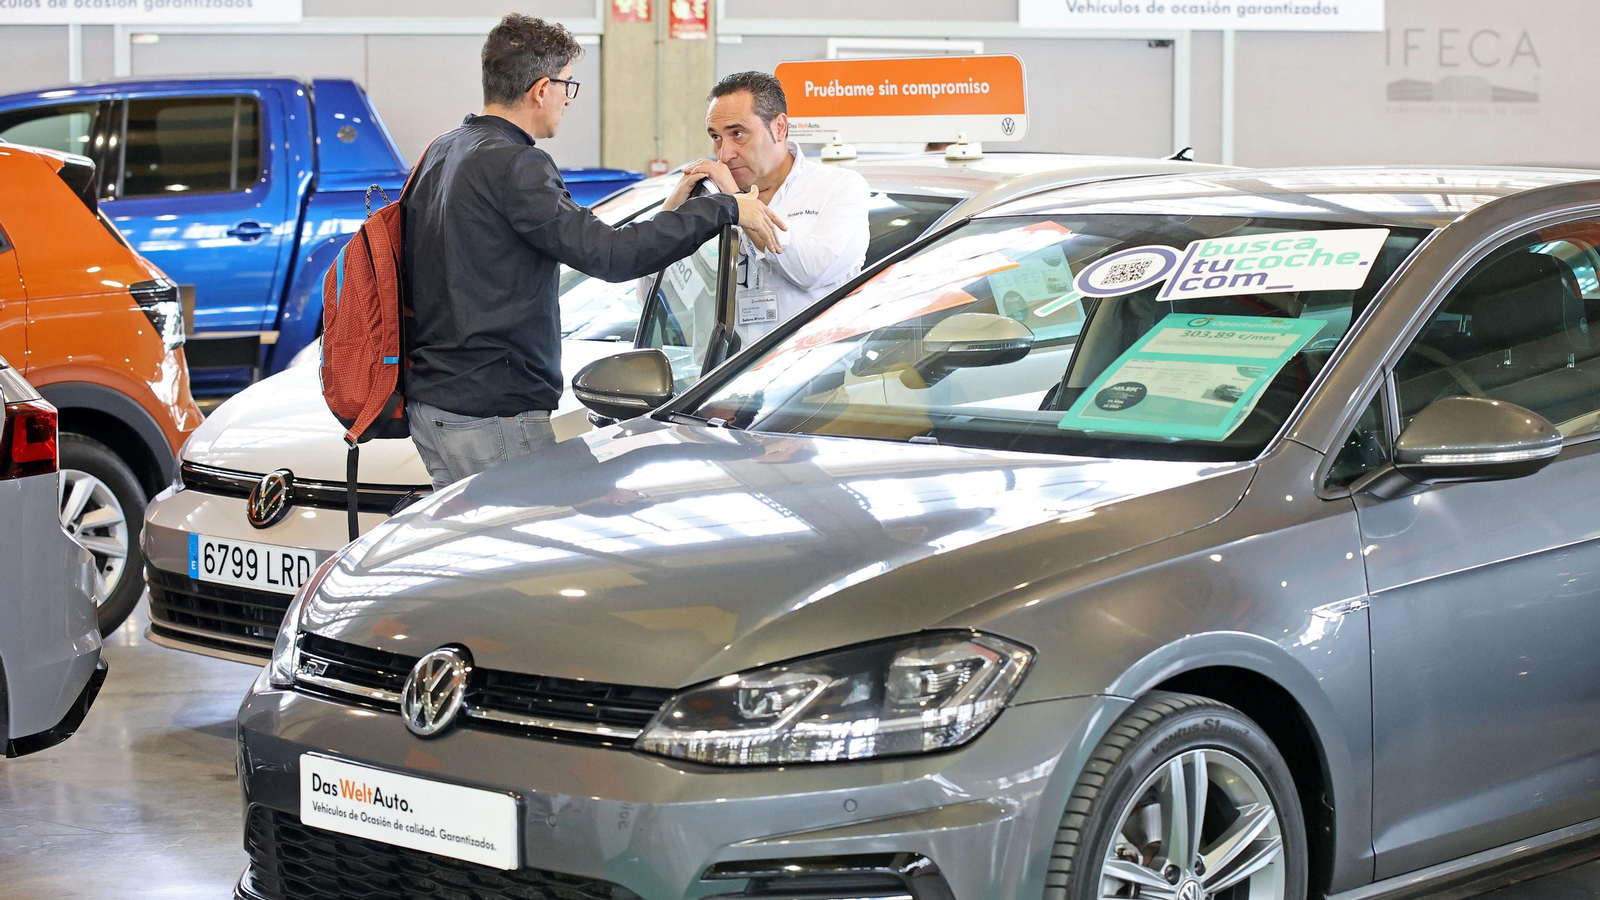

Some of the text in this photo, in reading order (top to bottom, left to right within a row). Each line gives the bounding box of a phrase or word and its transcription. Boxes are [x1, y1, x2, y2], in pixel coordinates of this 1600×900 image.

[1146, 0, 1165, 14] de
[1171, 0, 1231, 14] ocasión
[1236, 0, 1339, 18] garantizados
[1385, 27, 1541, 68] IFECA
[804, 77, 990, 99] Pruébame sin compromiso
[1198, 237, 1318, 258] busca
[1192, 247, 1369, 274] tucoche.
[1179, 330, 1236, 339] 303,89
[1211, 320, 1294, 330] Oportunidad
[191, 560, 196, 570] E
[204, 542, 310, 588] 6799 LRD
[312, 772, 414, 813] Das WeltAuto.
[349, 808, 359, 820] de
[360, 811, 392, 828] Ocasión
[393, 819, 404, 831] de
[405, 822, 437, 838] calidad.
[439, 829, 497, 851] Garantizados.
